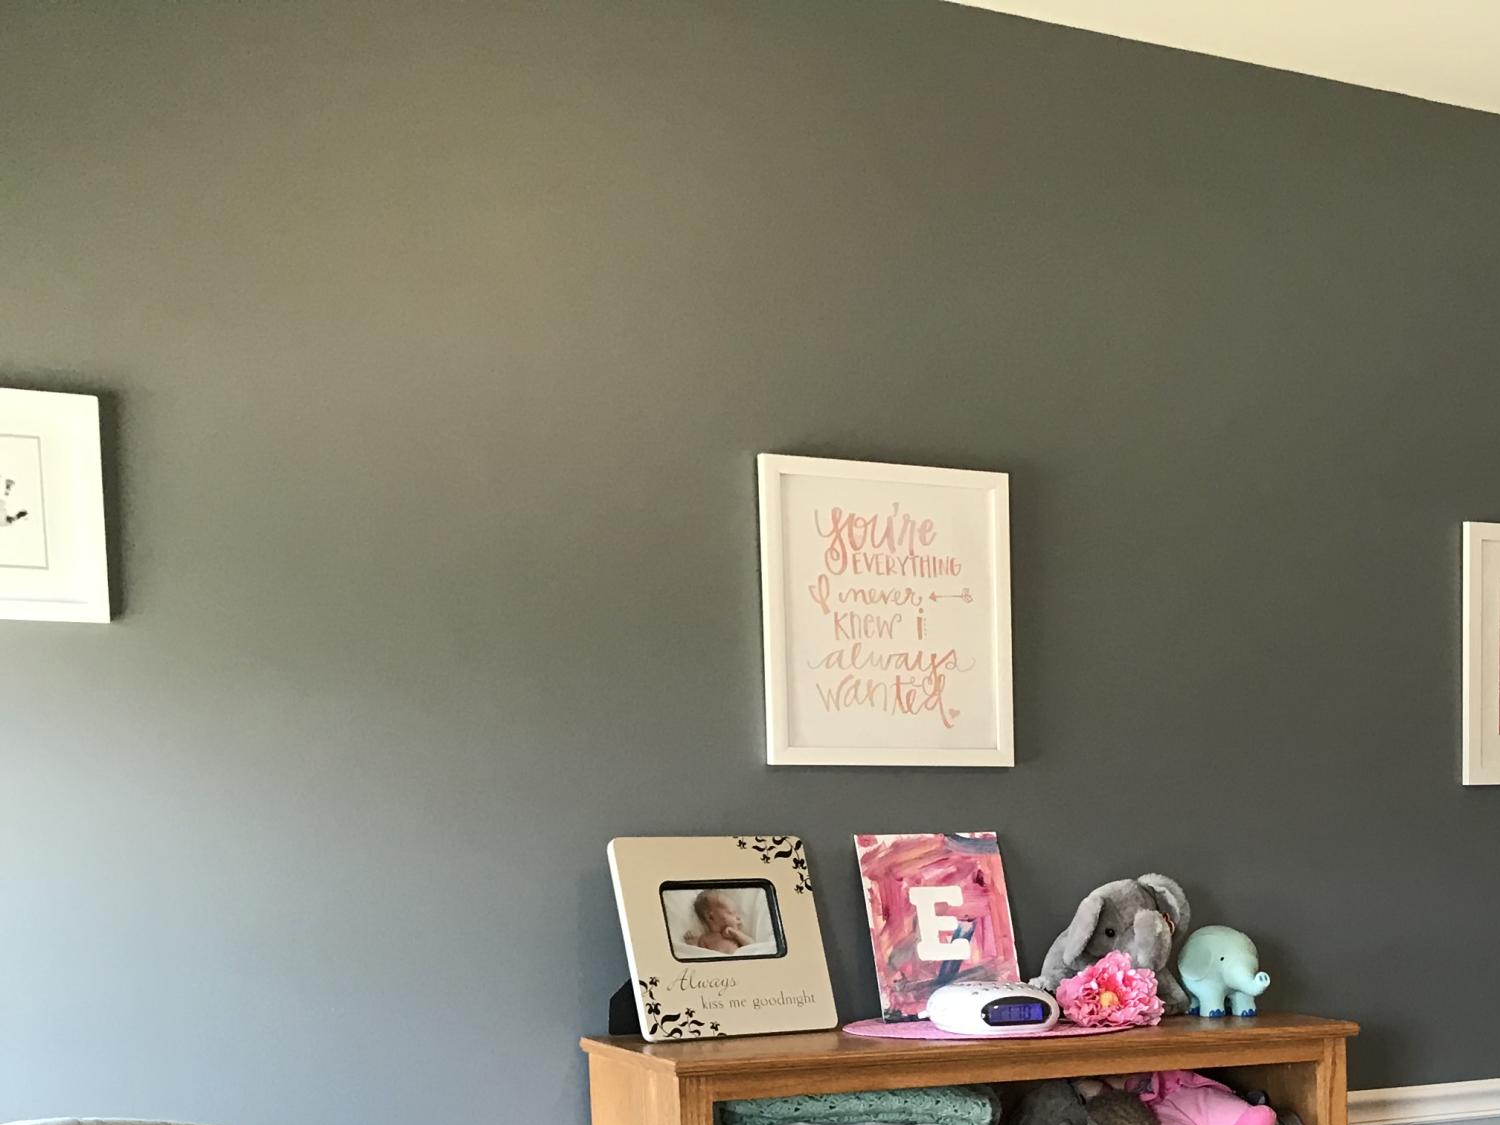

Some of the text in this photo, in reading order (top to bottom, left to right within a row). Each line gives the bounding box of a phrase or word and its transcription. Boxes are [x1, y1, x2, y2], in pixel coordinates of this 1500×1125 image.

[814, 502, 937, 575] you're
[852, 552, 962, 578] EVERYTHING
[839, 587, 923, 606] never
[807, 642, 976, 696] always
[816, 674, 954, 728] wanted
[908, 885, 972, 961] E
[666, 968, 738, 997] Always
[700, 990, 816, 1009] kiss me goodnight
